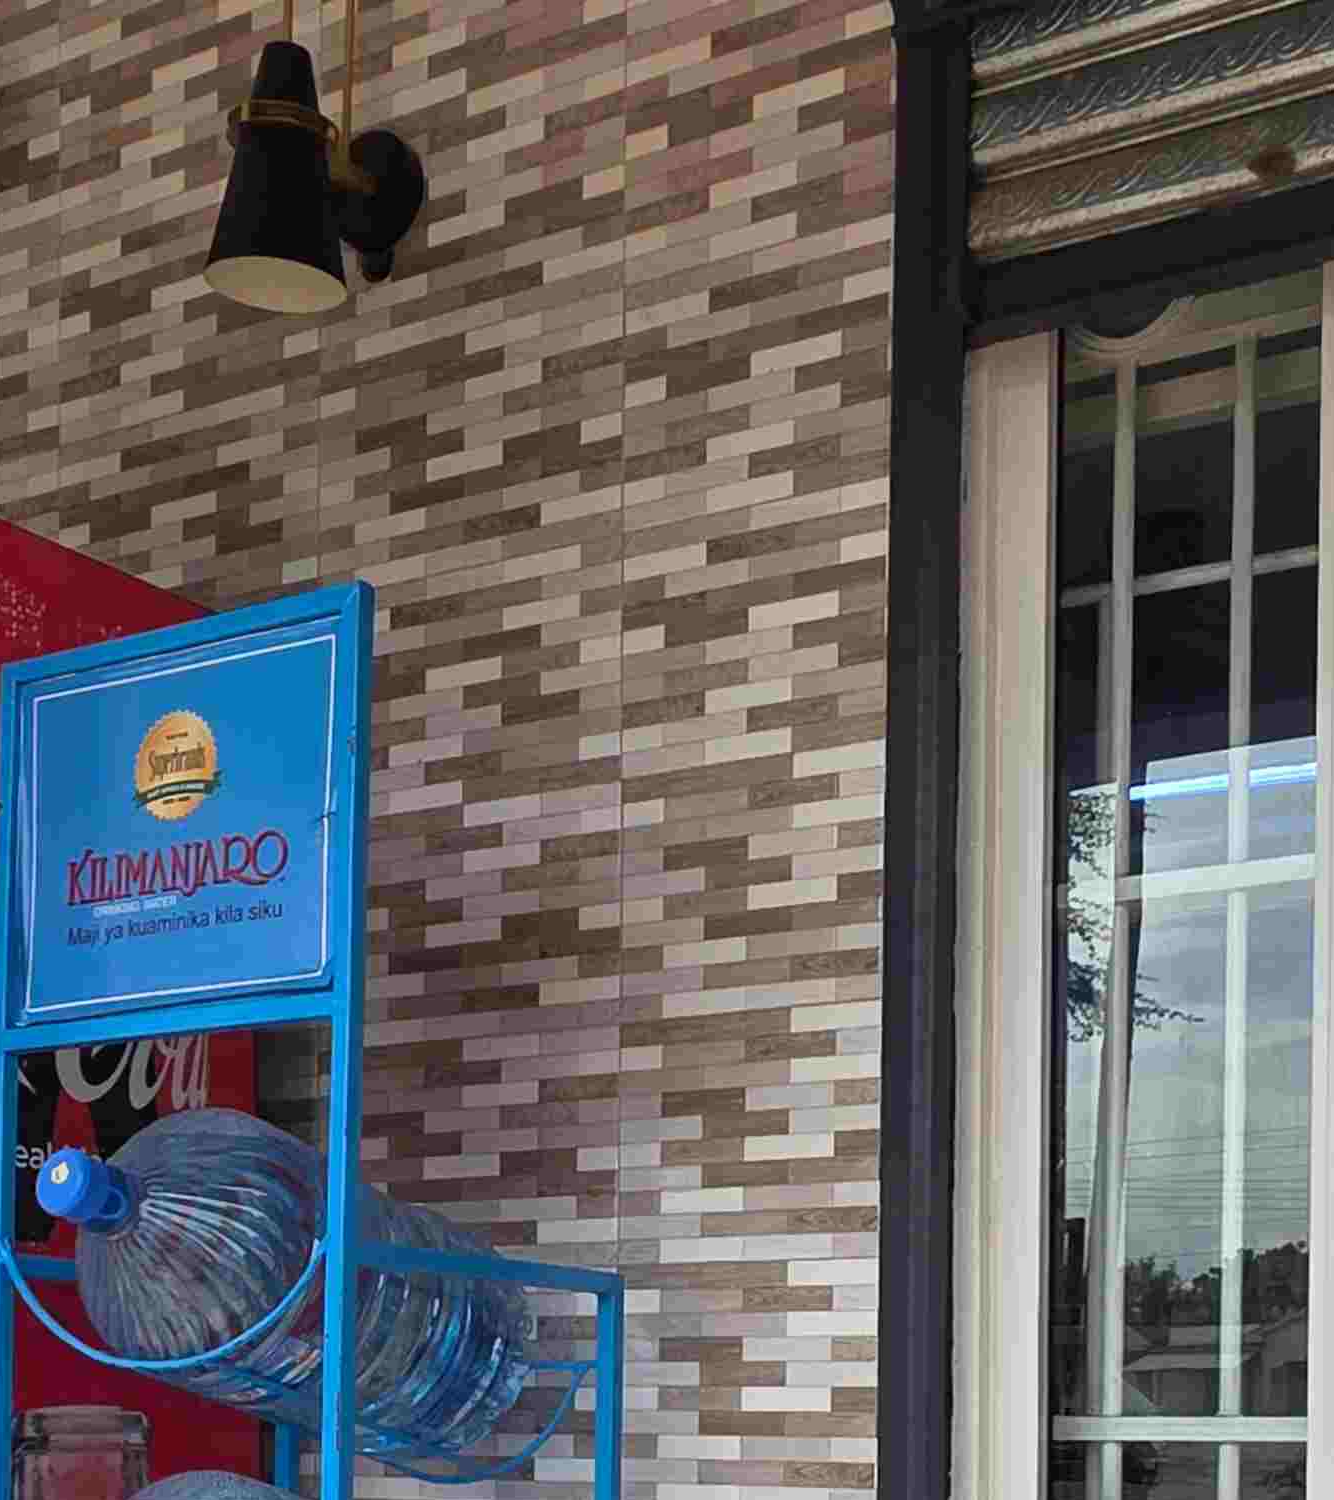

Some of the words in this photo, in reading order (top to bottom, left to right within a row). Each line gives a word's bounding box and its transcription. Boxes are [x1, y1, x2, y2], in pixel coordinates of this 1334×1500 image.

[67, 829, 289, 906] KILIMANJARO
[68, 925, 99, 949] Maji
[104, 925, 124, 945] ya
[128, 910, 210, 938] kuaminika
[215, 905, 243, 925] kila
[247, 901, 284, 921] siku
